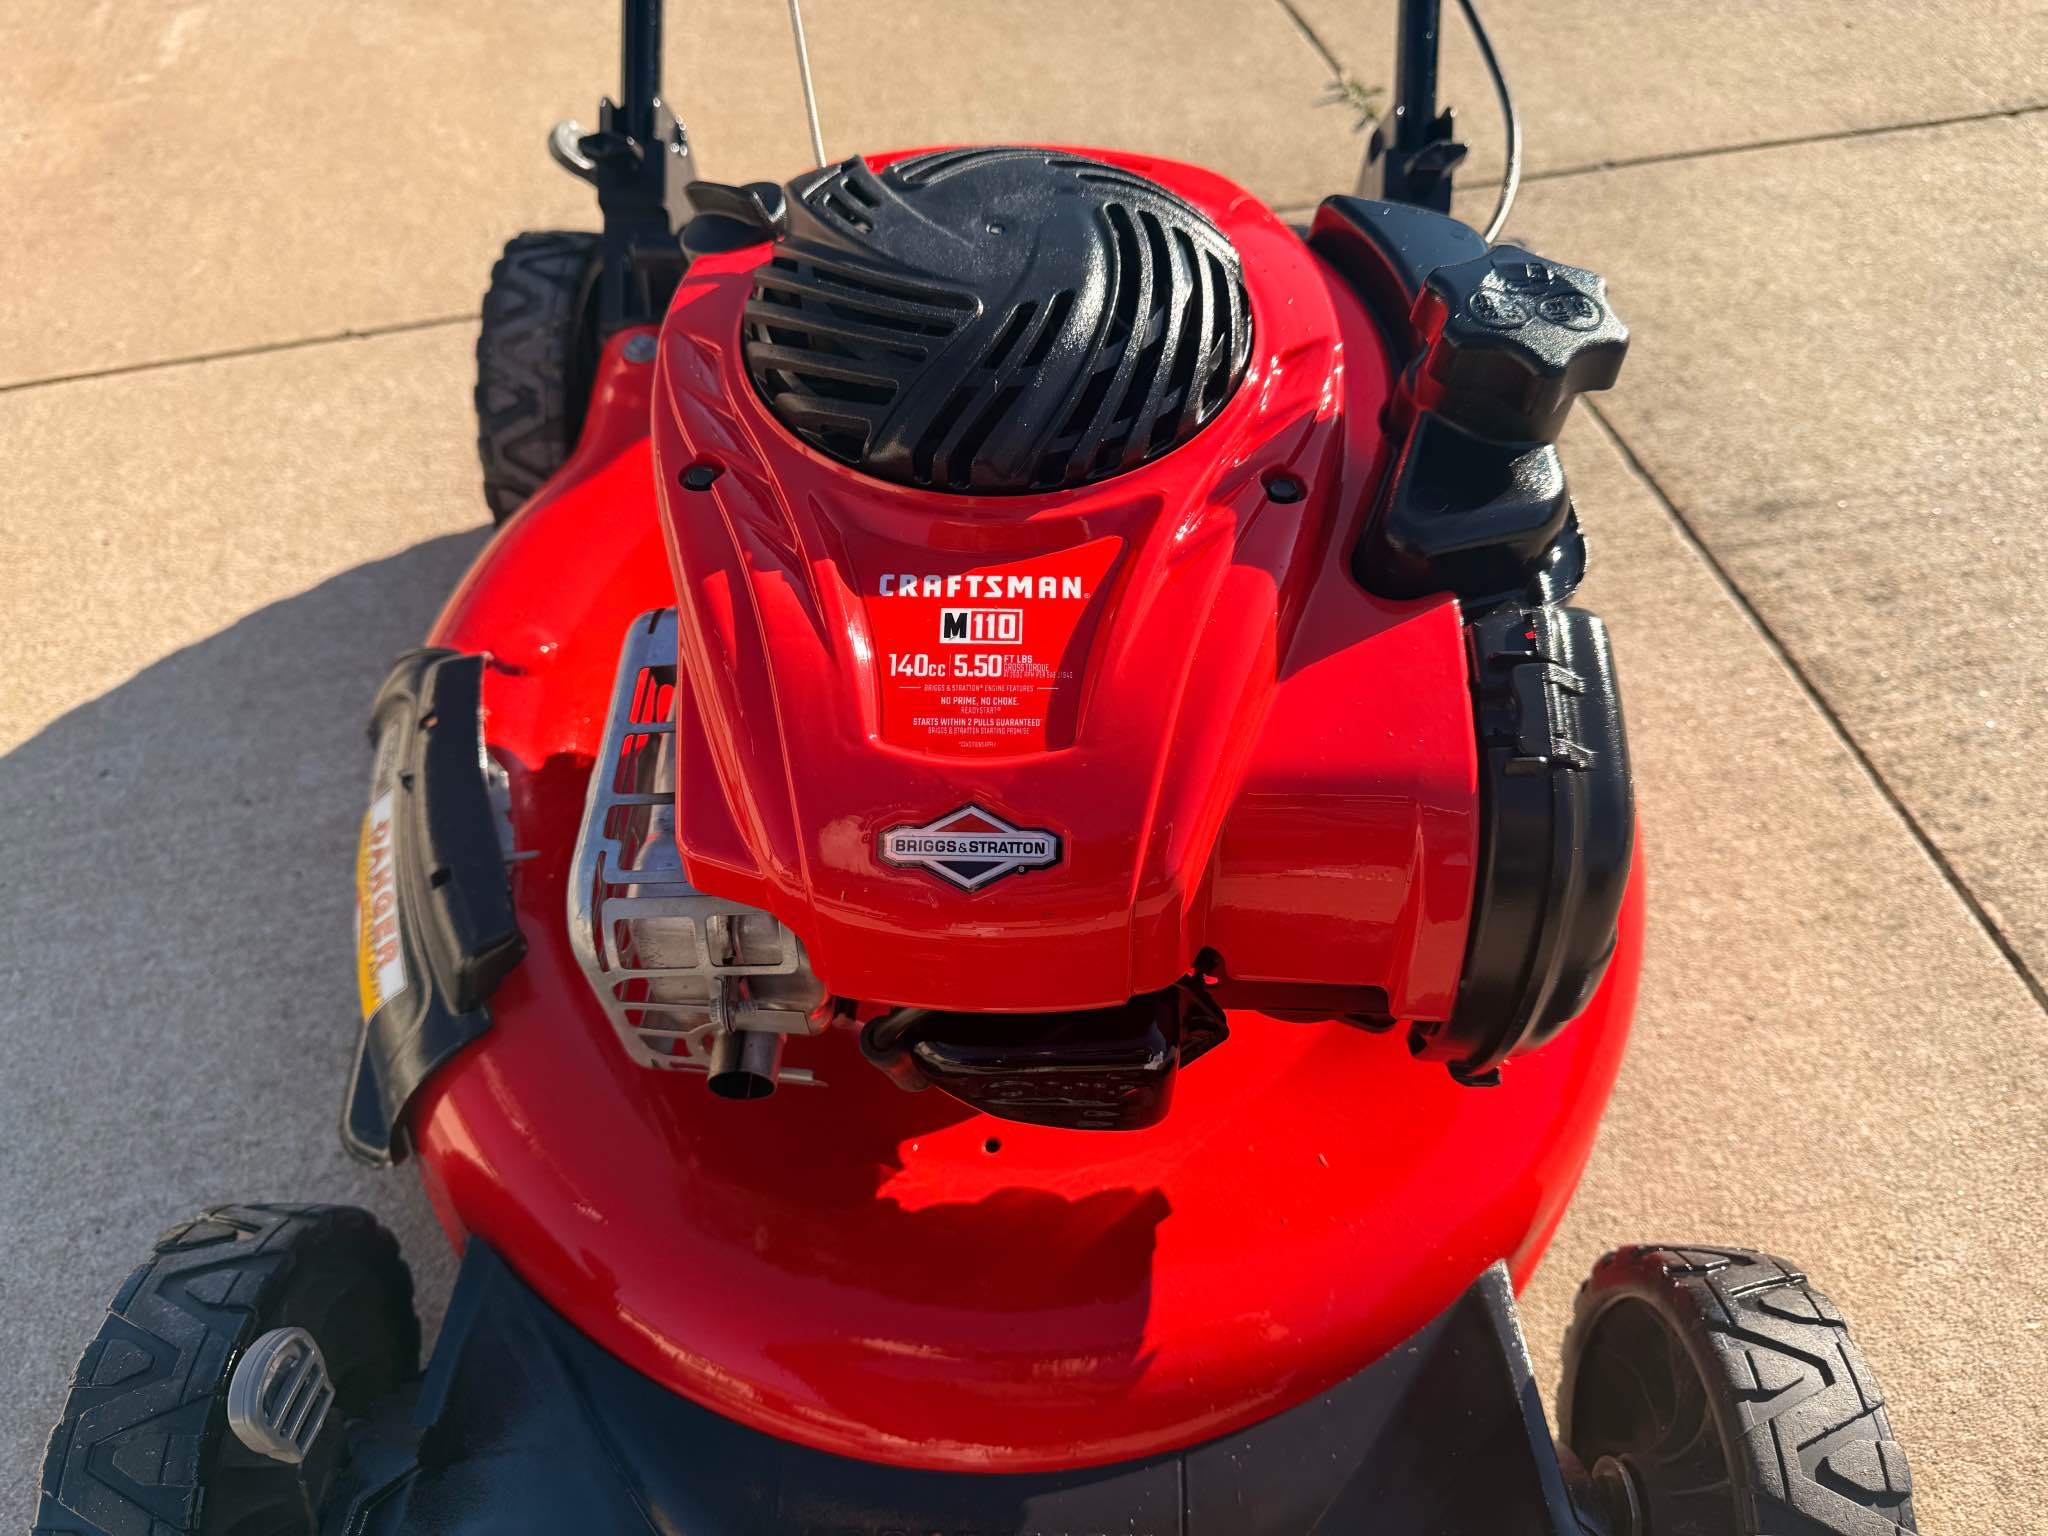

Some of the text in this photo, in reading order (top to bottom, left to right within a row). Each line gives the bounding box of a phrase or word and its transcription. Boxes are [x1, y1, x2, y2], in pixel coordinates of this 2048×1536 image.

[943, 612, 1017, 639] M110
[954, 653, 1002, 678] 5.50
[1003, 654, 1033, 664] FT LBS
[940, 696, 951, 705] NO
[980, 696, 991, 706] NO
[913, 717, 939, 726] STARTS
[940, 717, 966, 726] WITHIN
[967, 718, 972, 726] 2
[973, 718, 995, 727] PULLS
[369, 818, 399, 969] DANGER
